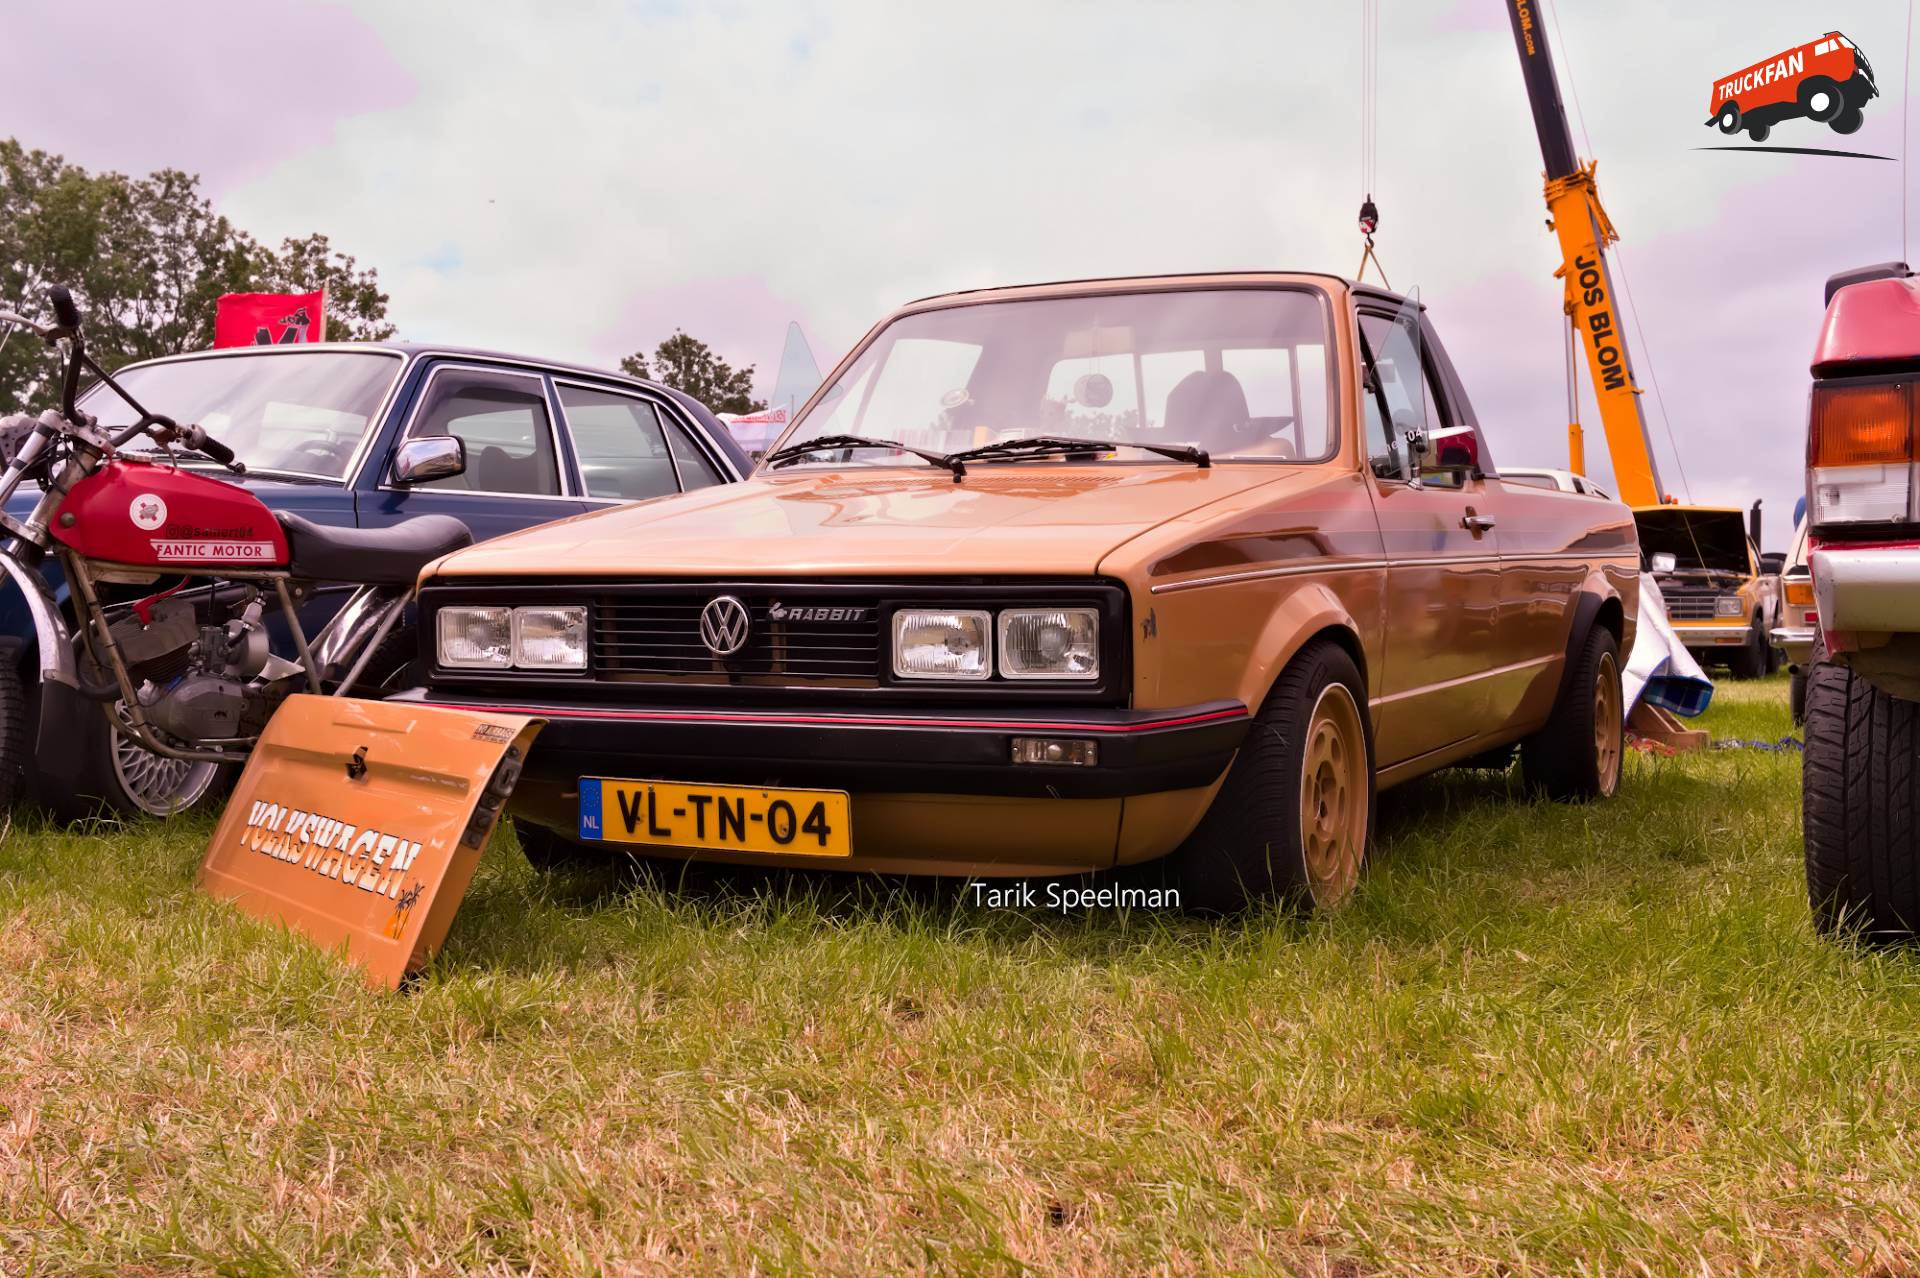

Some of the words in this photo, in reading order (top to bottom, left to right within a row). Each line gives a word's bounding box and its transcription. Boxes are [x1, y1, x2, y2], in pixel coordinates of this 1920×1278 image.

[1575, 255, 1604, 307] JOS
[1588, 311, 1626, 391] BLOM
[155, 544, 206, 558] FANTIC
[212, 545, 263, 557] MOTOR
[788, 608, 865, 621] RABBIT
[583, 815, 600, 830] NL
[616, 789, 831, 847] VL-TN-04
[240, 800, 424, 900] VOLKSWAGEN
